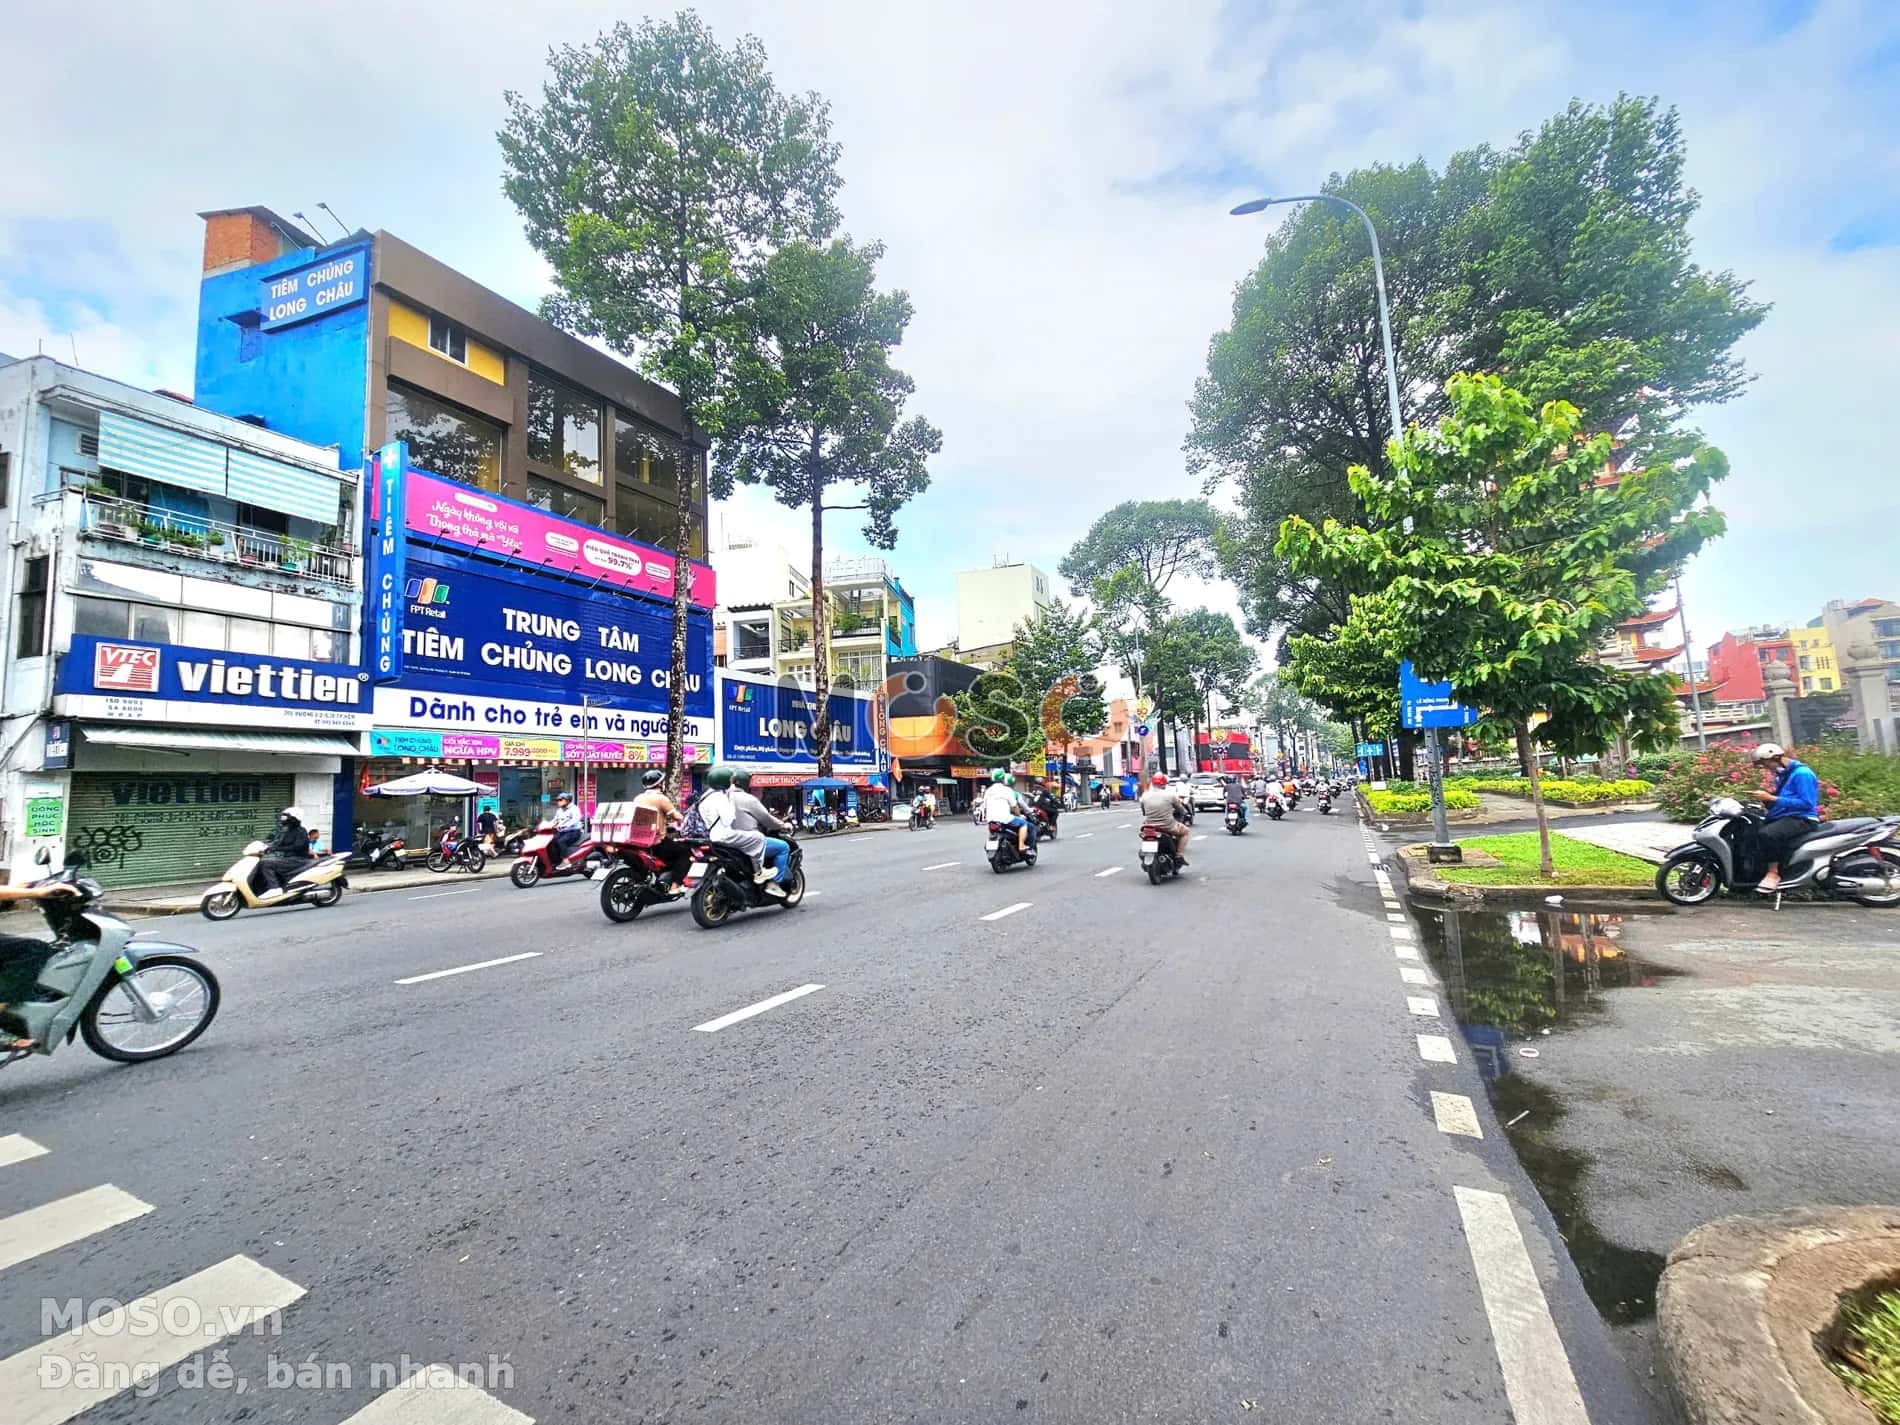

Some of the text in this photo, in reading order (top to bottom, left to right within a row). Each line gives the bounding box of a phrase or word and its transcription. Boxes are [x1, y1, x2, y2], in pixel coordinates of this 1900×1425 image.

[271, 258, 355, 299] TIÊM CHỦNG
[269, 281, 354, 321] LONG CHÂU
[379, 478, 394, 673] TIÊM CHỦNG
[410, 604, 447, 619] FPT Retail
[502, 607, 639, 654] TRUNG TÂM
[102, 647, 156, 667] VTEC
[402, 626, 465, 662] TIÊM
[481, 639, 573, 676] CHỦNG
[585, 657, 642, 686] LONG
[408, 696, 475, 721] Dành
[485, 700, 528, 725] cho
[535, 703, 562, 728] trẻ
[570, 714, 598, 729] em
[605, 714, 625, 731] và
[759, 717, 807, 739] LONG
[476, 748, 498, 756] HPV
[628, 750, 644, 761] 8%
